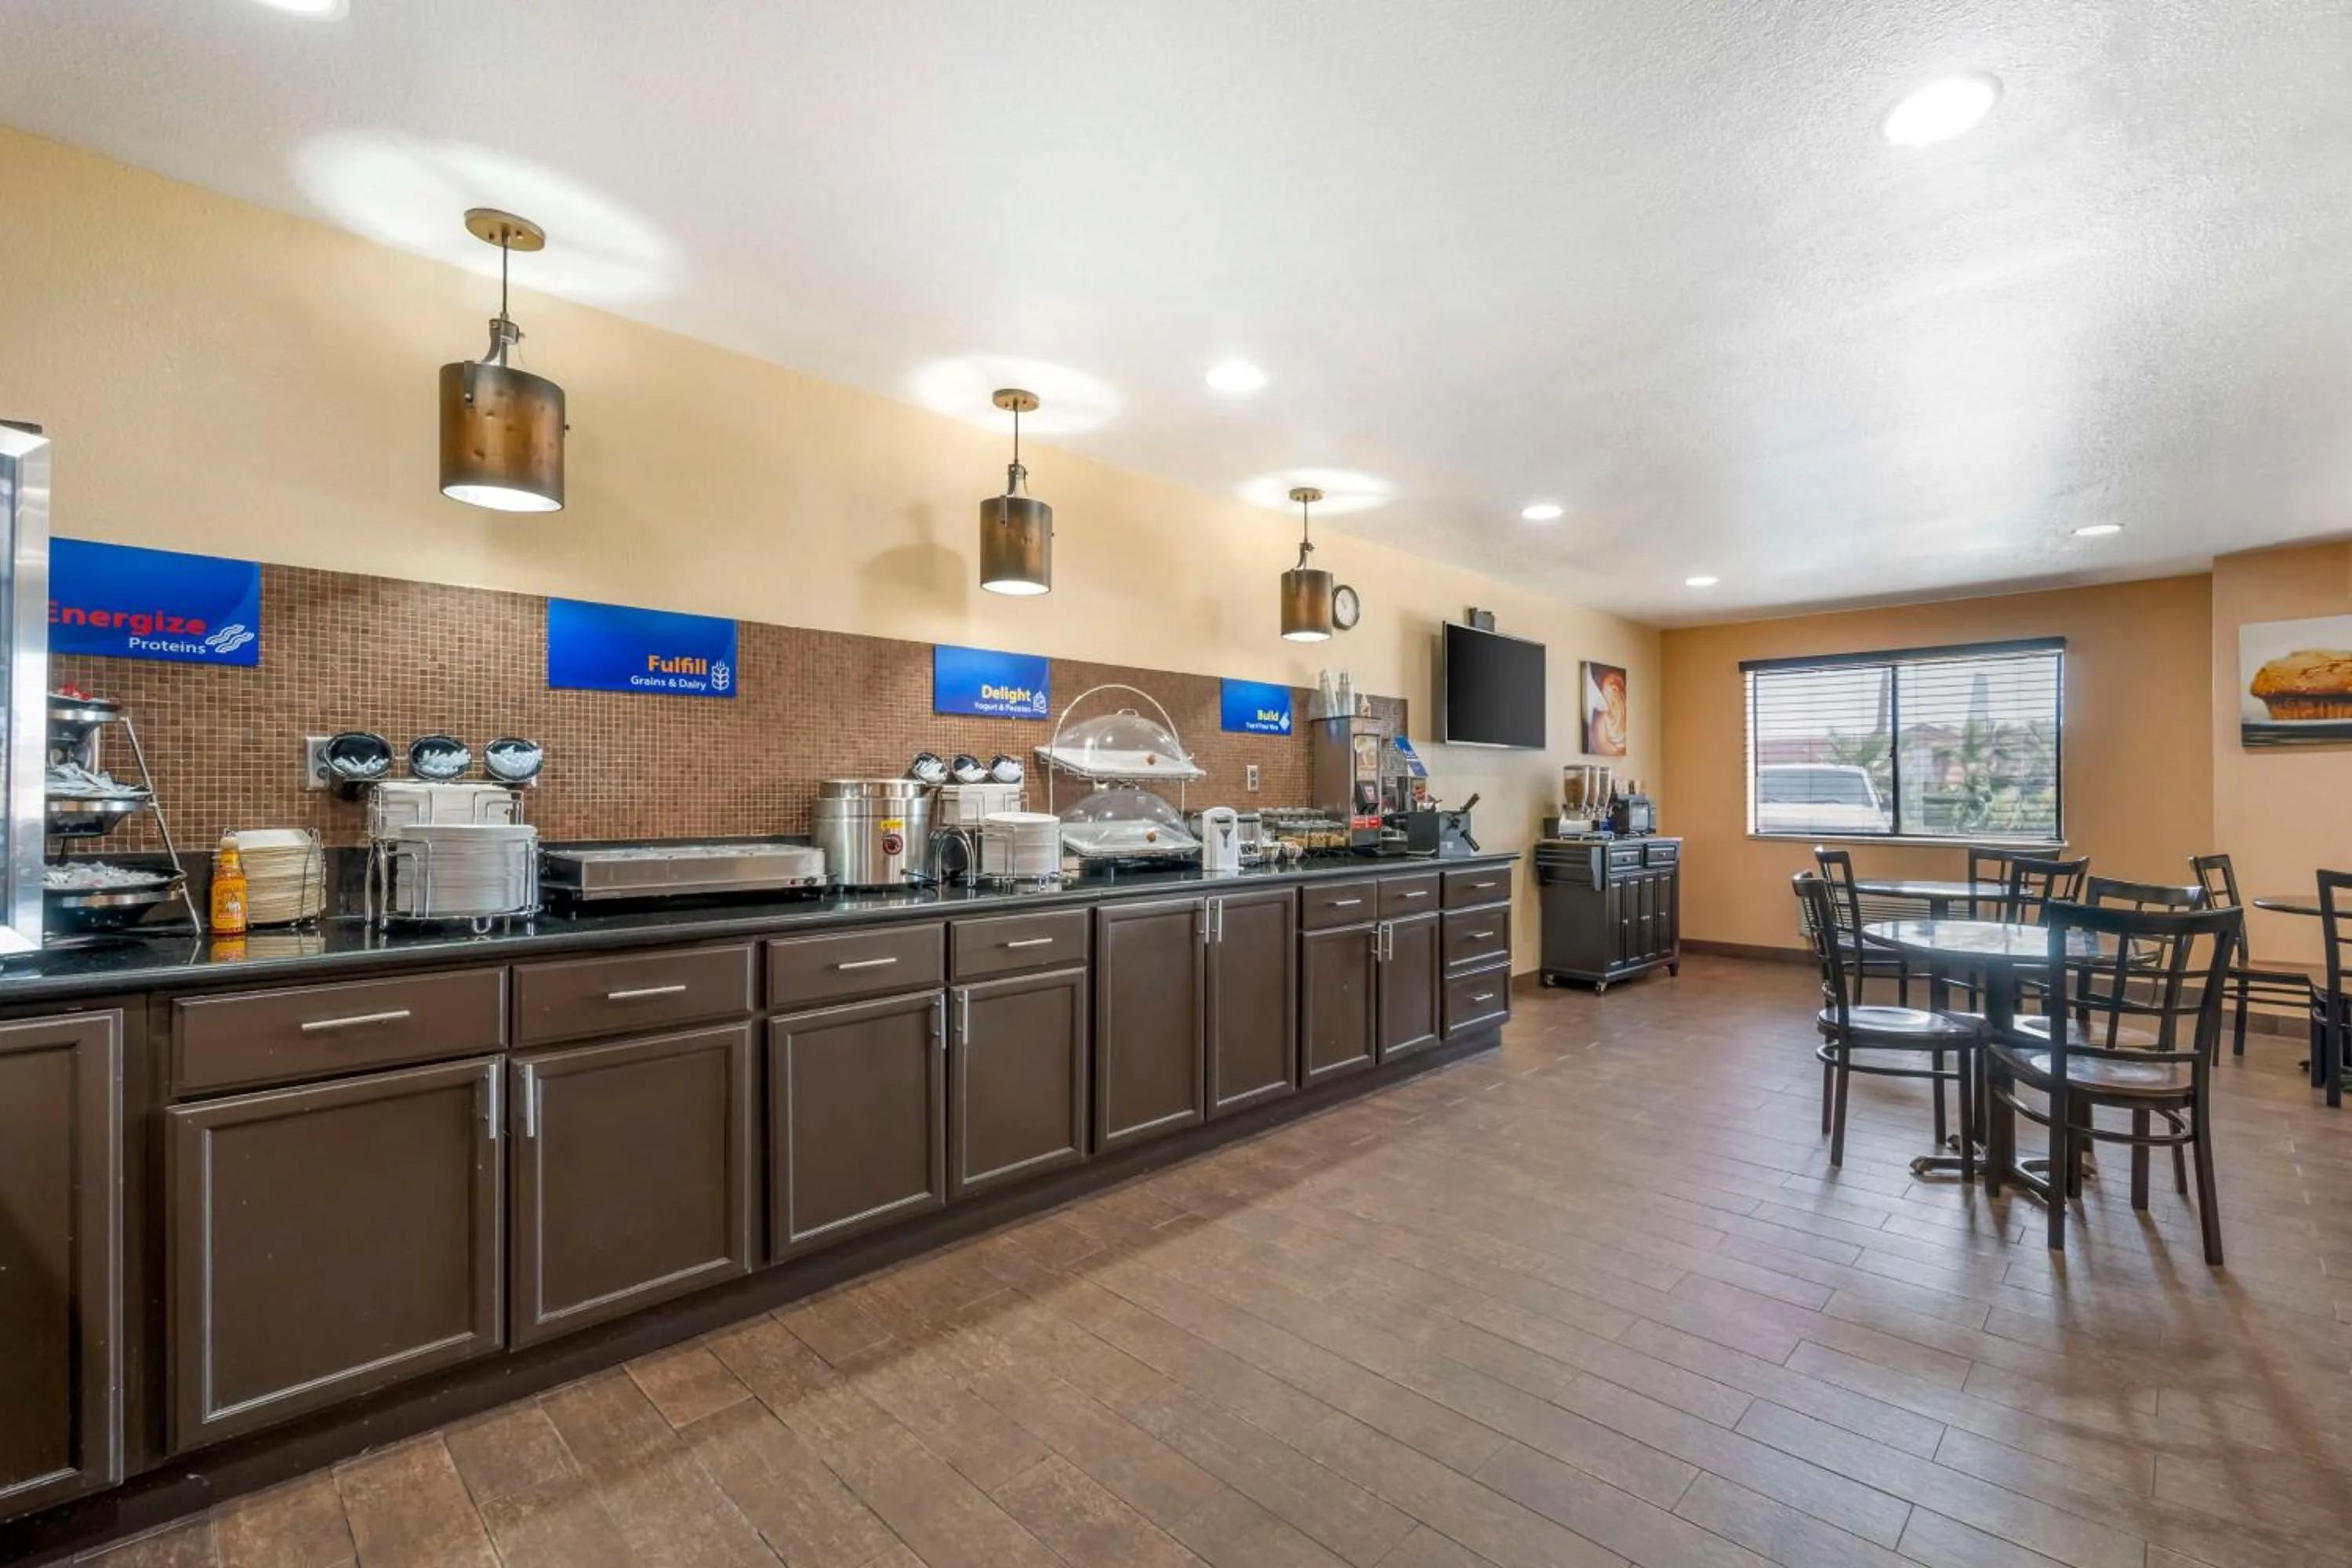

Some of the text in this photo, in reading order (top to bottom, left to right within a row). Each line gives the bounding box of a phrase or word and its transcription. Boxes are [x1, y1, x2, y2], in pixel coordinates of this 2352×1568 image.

[129, 636, 206, 655] Proteins
[648, 654, 707, 675] Fulfill
[630, 674, 707, 691] Grains & Dairy
[981, 684, 1032, 705] Delight
[1257, 709, 1279, 722] Build
